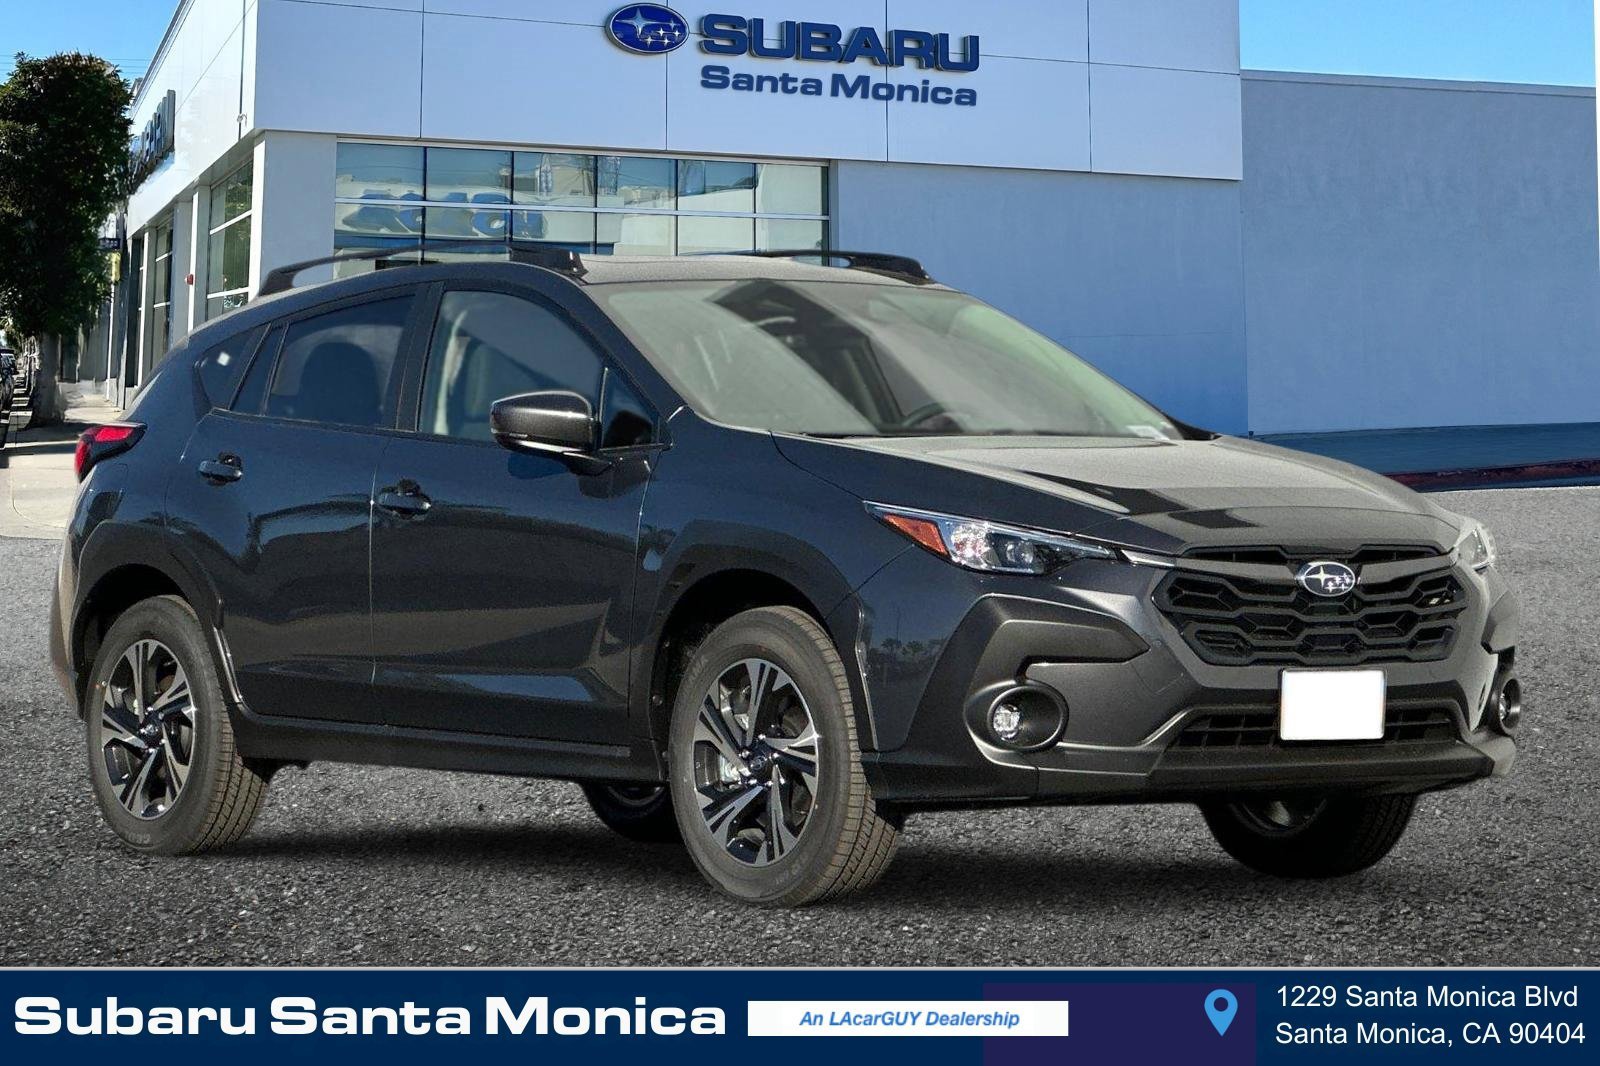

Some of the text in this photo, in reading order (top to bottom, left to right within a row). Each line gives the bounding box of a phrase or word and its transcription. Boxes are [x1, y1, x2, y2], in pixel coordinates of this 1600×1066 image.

[700, 13, 980, 72] SUBARU
[700, 64, 977, 106] Santa Monica
